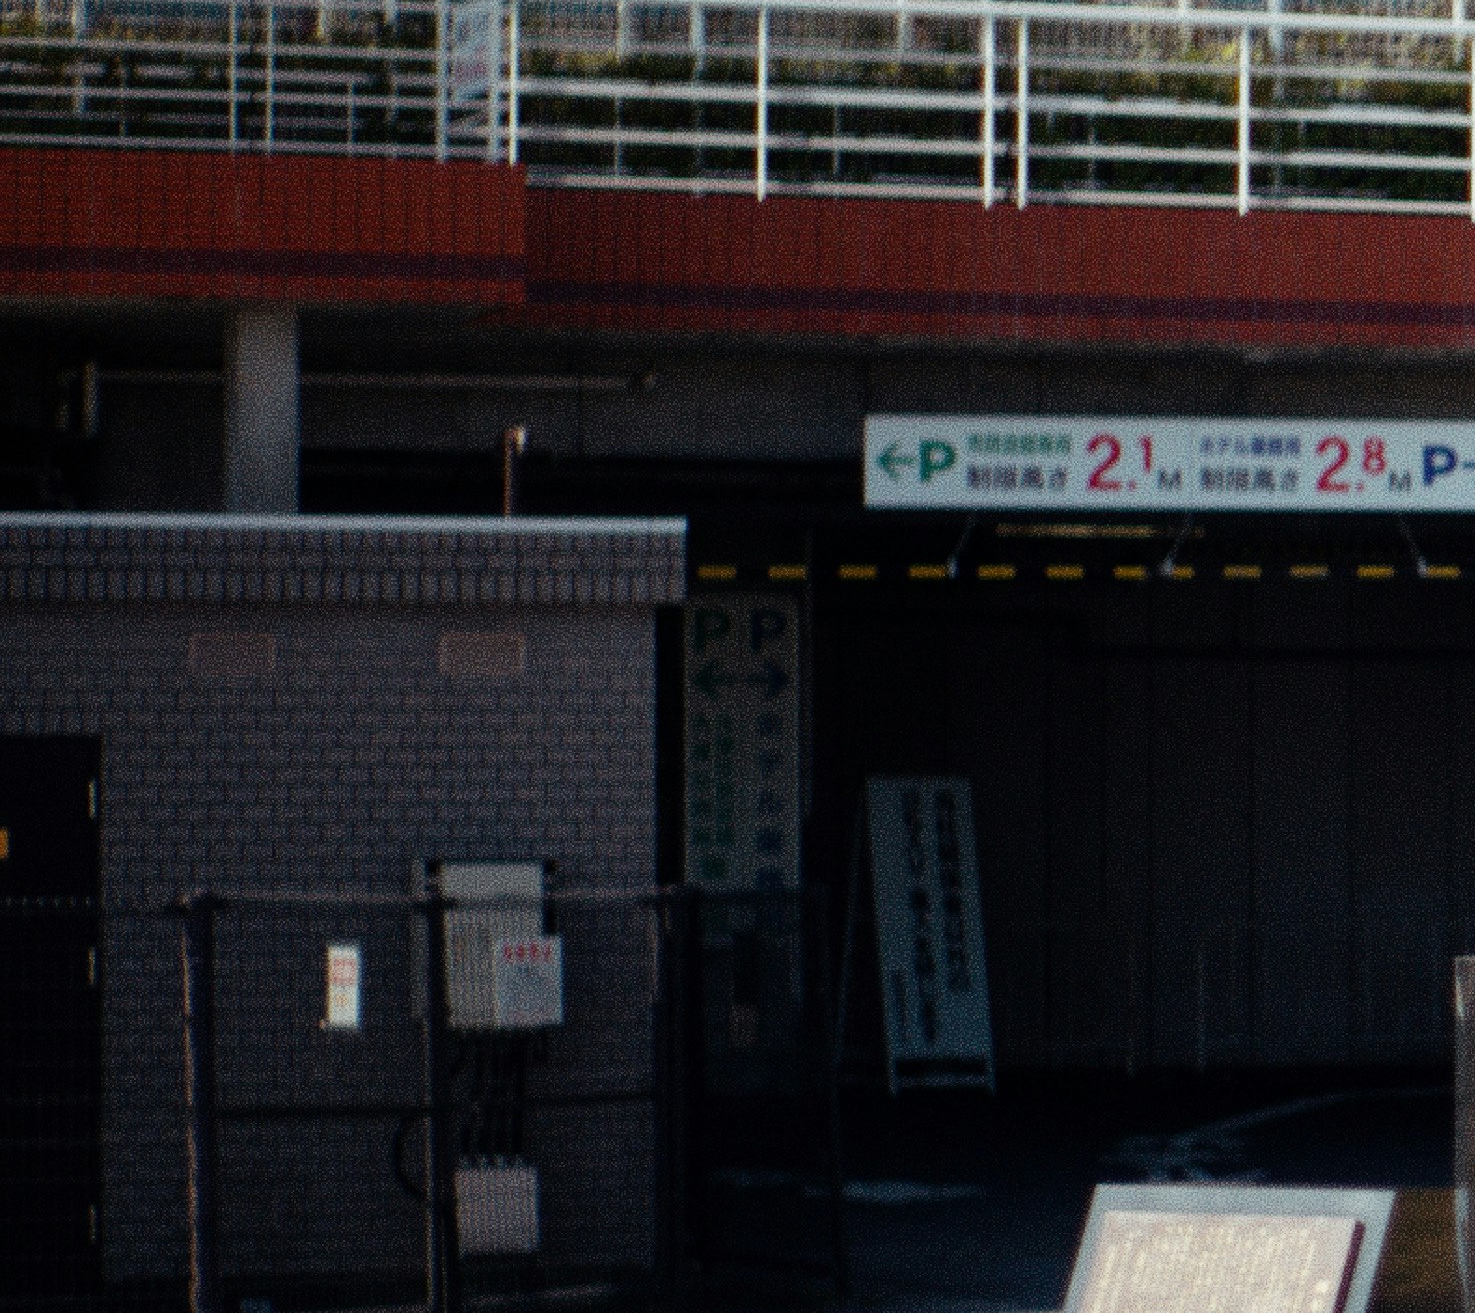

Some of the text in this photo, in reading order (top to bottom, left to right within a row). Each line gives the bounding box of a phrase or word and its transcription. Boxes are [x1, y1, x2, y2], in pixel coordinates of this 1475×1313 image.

[918, 439, 957, 483] P
[1422, 444, 1459, 487] P
[694, 607, 787, 652] P P
